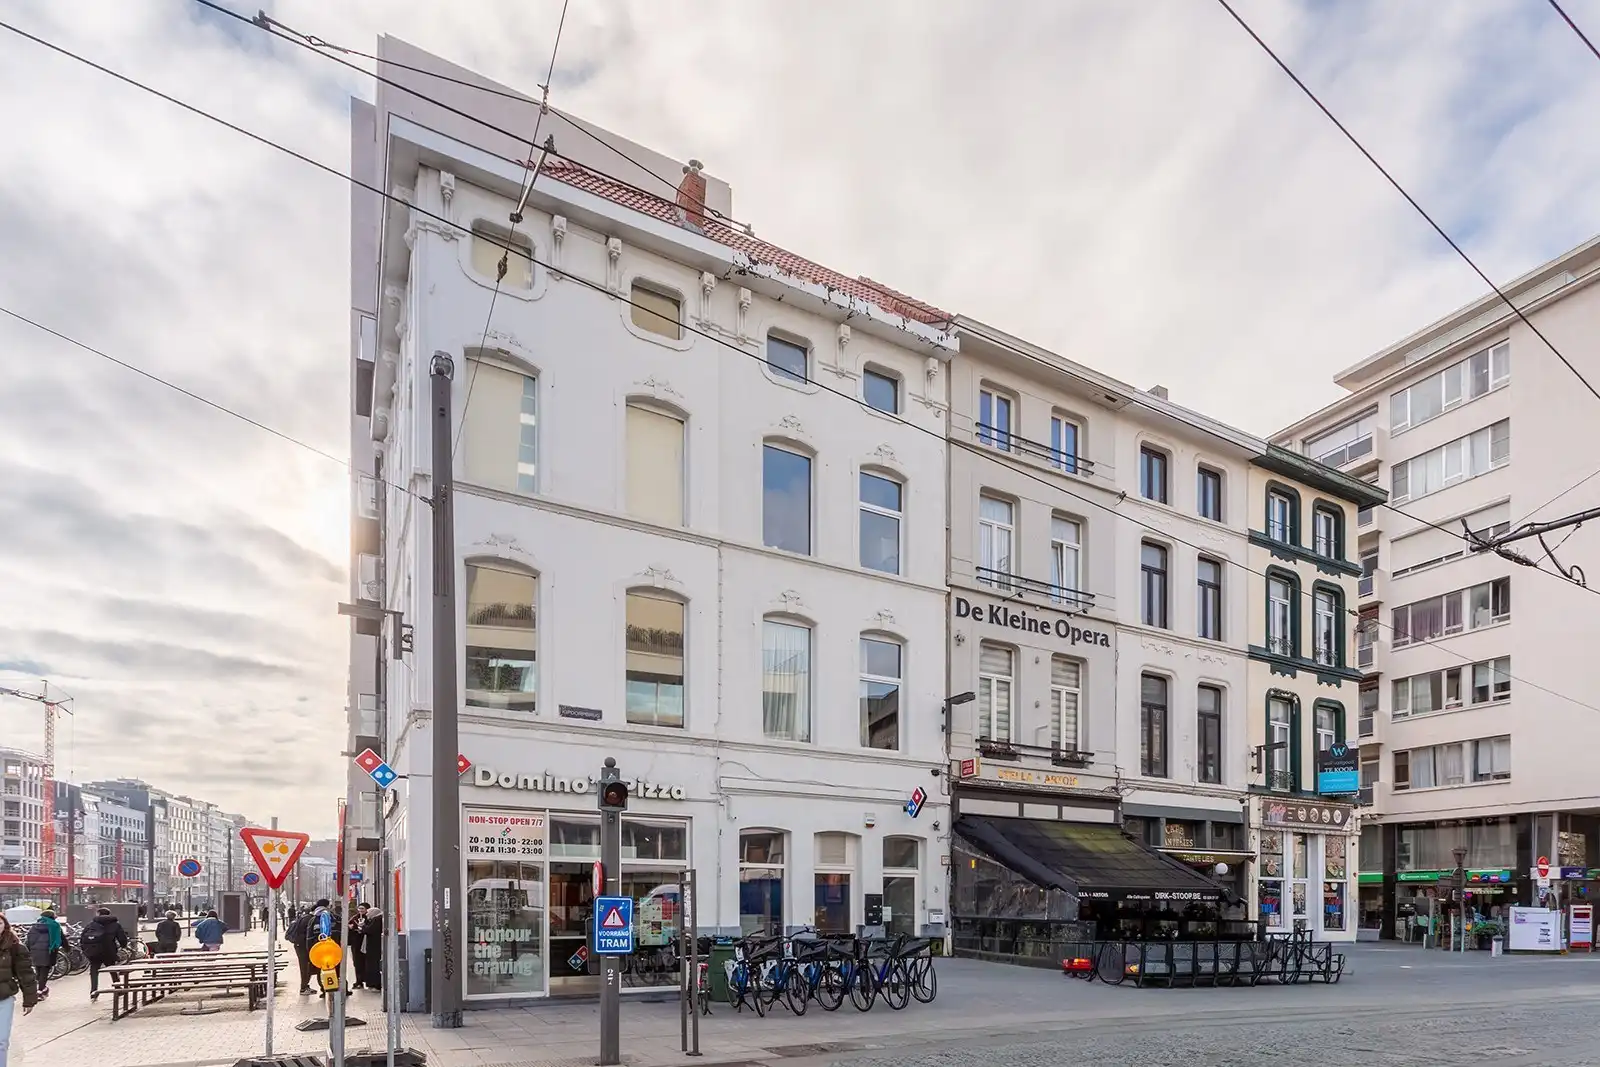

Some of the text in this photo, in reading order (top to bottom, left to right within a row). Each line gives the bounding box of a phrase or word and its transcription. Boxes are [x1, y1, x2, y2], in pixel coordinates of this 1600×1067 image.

[955, 597, 1110, 648] De Kleine Opera
[474, 764, 597, 794] Domino'
[468, 815, 509, 825] NON-STOP
[510, 817, 530, 826] OPEN
[469, 836, 479, 844] ZO
[498, 837, 516, 845] 11:30
[521, 838, 543, 846] 22:00
[469, 845, 479, 853] VR
[498, 846, 516, 854] 11:30
[521, 847, 543, 855] 23:00
[474, 926, 532, 942] honour
[600, 938, 628, 948] TRAM
[474, 943, 502, 958] the
[473, 959, 532, 976] craving
[327, 976, 334, 985] B
